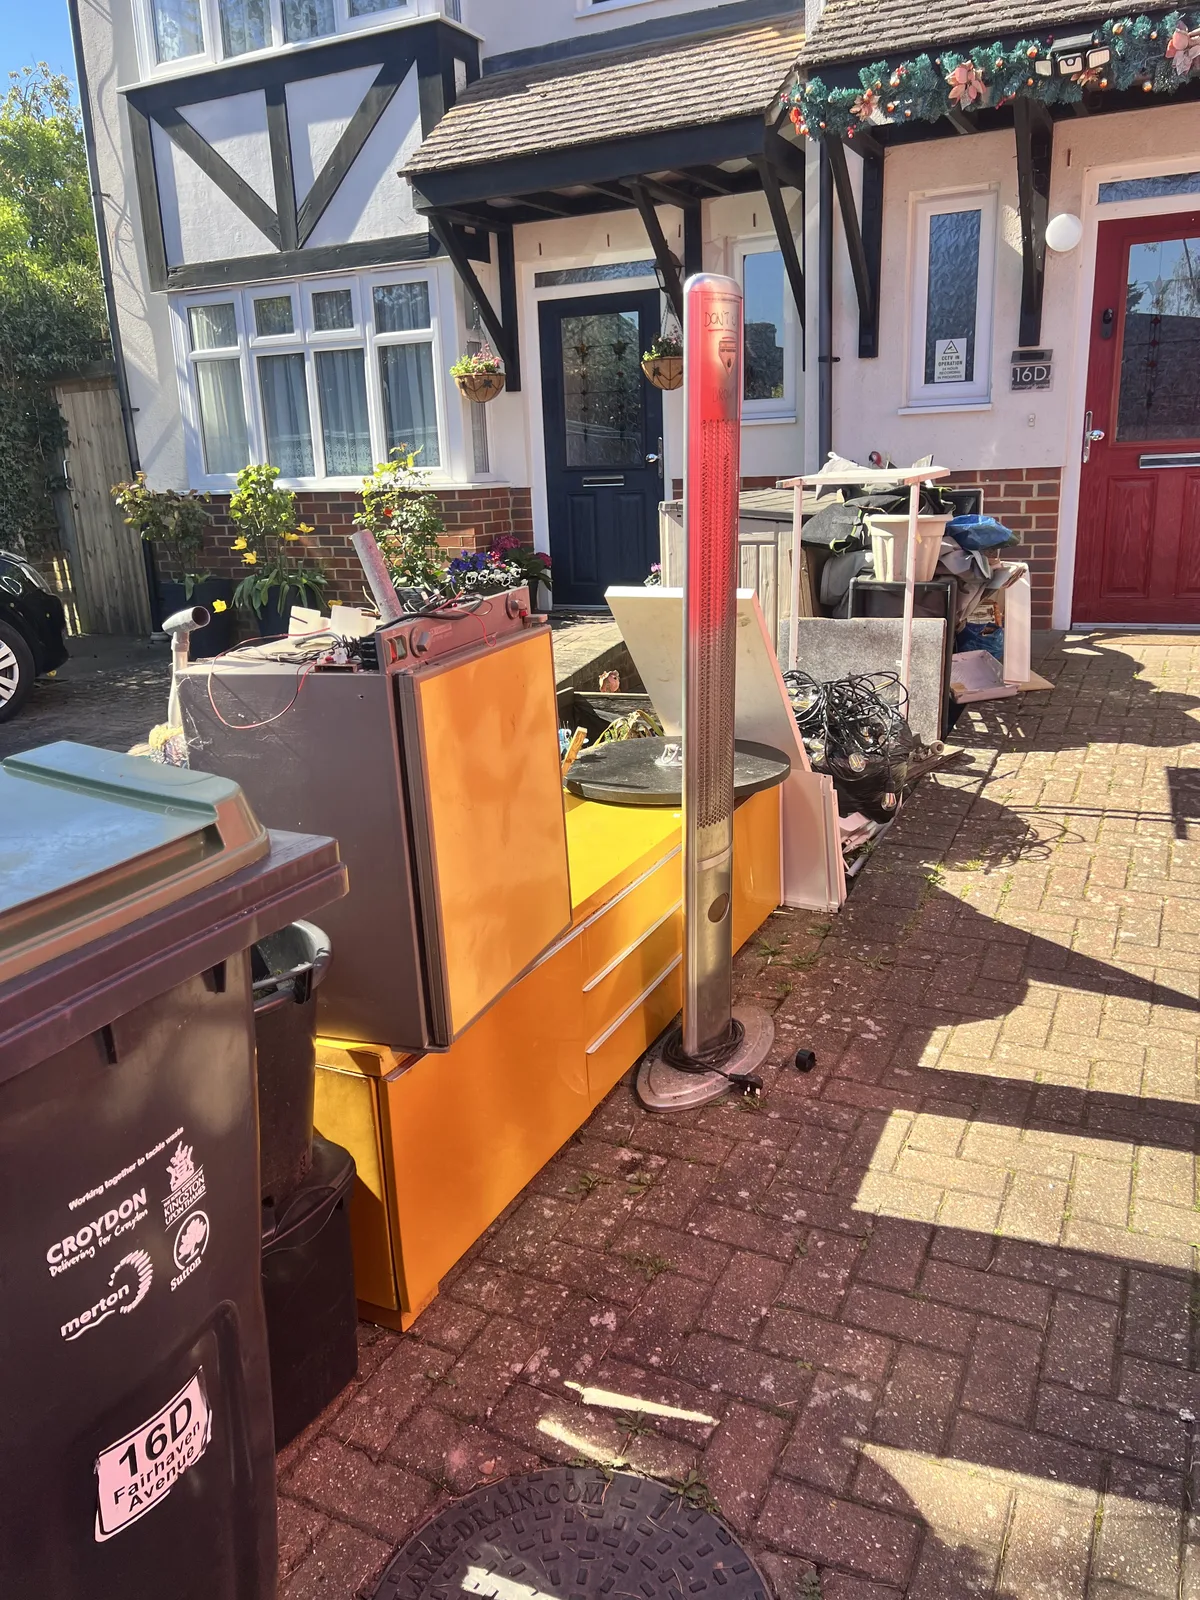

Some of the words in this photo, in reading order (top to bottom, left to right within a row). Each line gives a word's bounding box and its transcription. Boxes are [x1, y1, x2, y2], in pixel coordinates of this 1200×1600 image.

[1015, 366, 1047, 383] 16D
[68, 1184, 104, 1211] Working
[104, 1162, 137, 1188] together
[137, 1157, 146, 1166] to
[145, 1141, 166, 1160] tackle
[165, 1126, 184, 1145] waste
[164, 1174, 205, 1218] KINGSTON
[46, 1187, 148, 1264] CROYDON
[165, 1205, 184, 1226] UPON
[183, 1183, 206, 1208] THAMES
[49, 1245, 96, 1277] Delivering
[98, 1233, 112, 1248] for
[114, 1209, 149, 1236] Croydon
[170, 1256, 202, 1292] Sutton
[60, 1284, 130, 1337] merton
[113, 1420, 200, 1506] Fairhaven
[119, 1397, 192, 1478] 16D
[128, 1446, 195, 1513] Avenue
